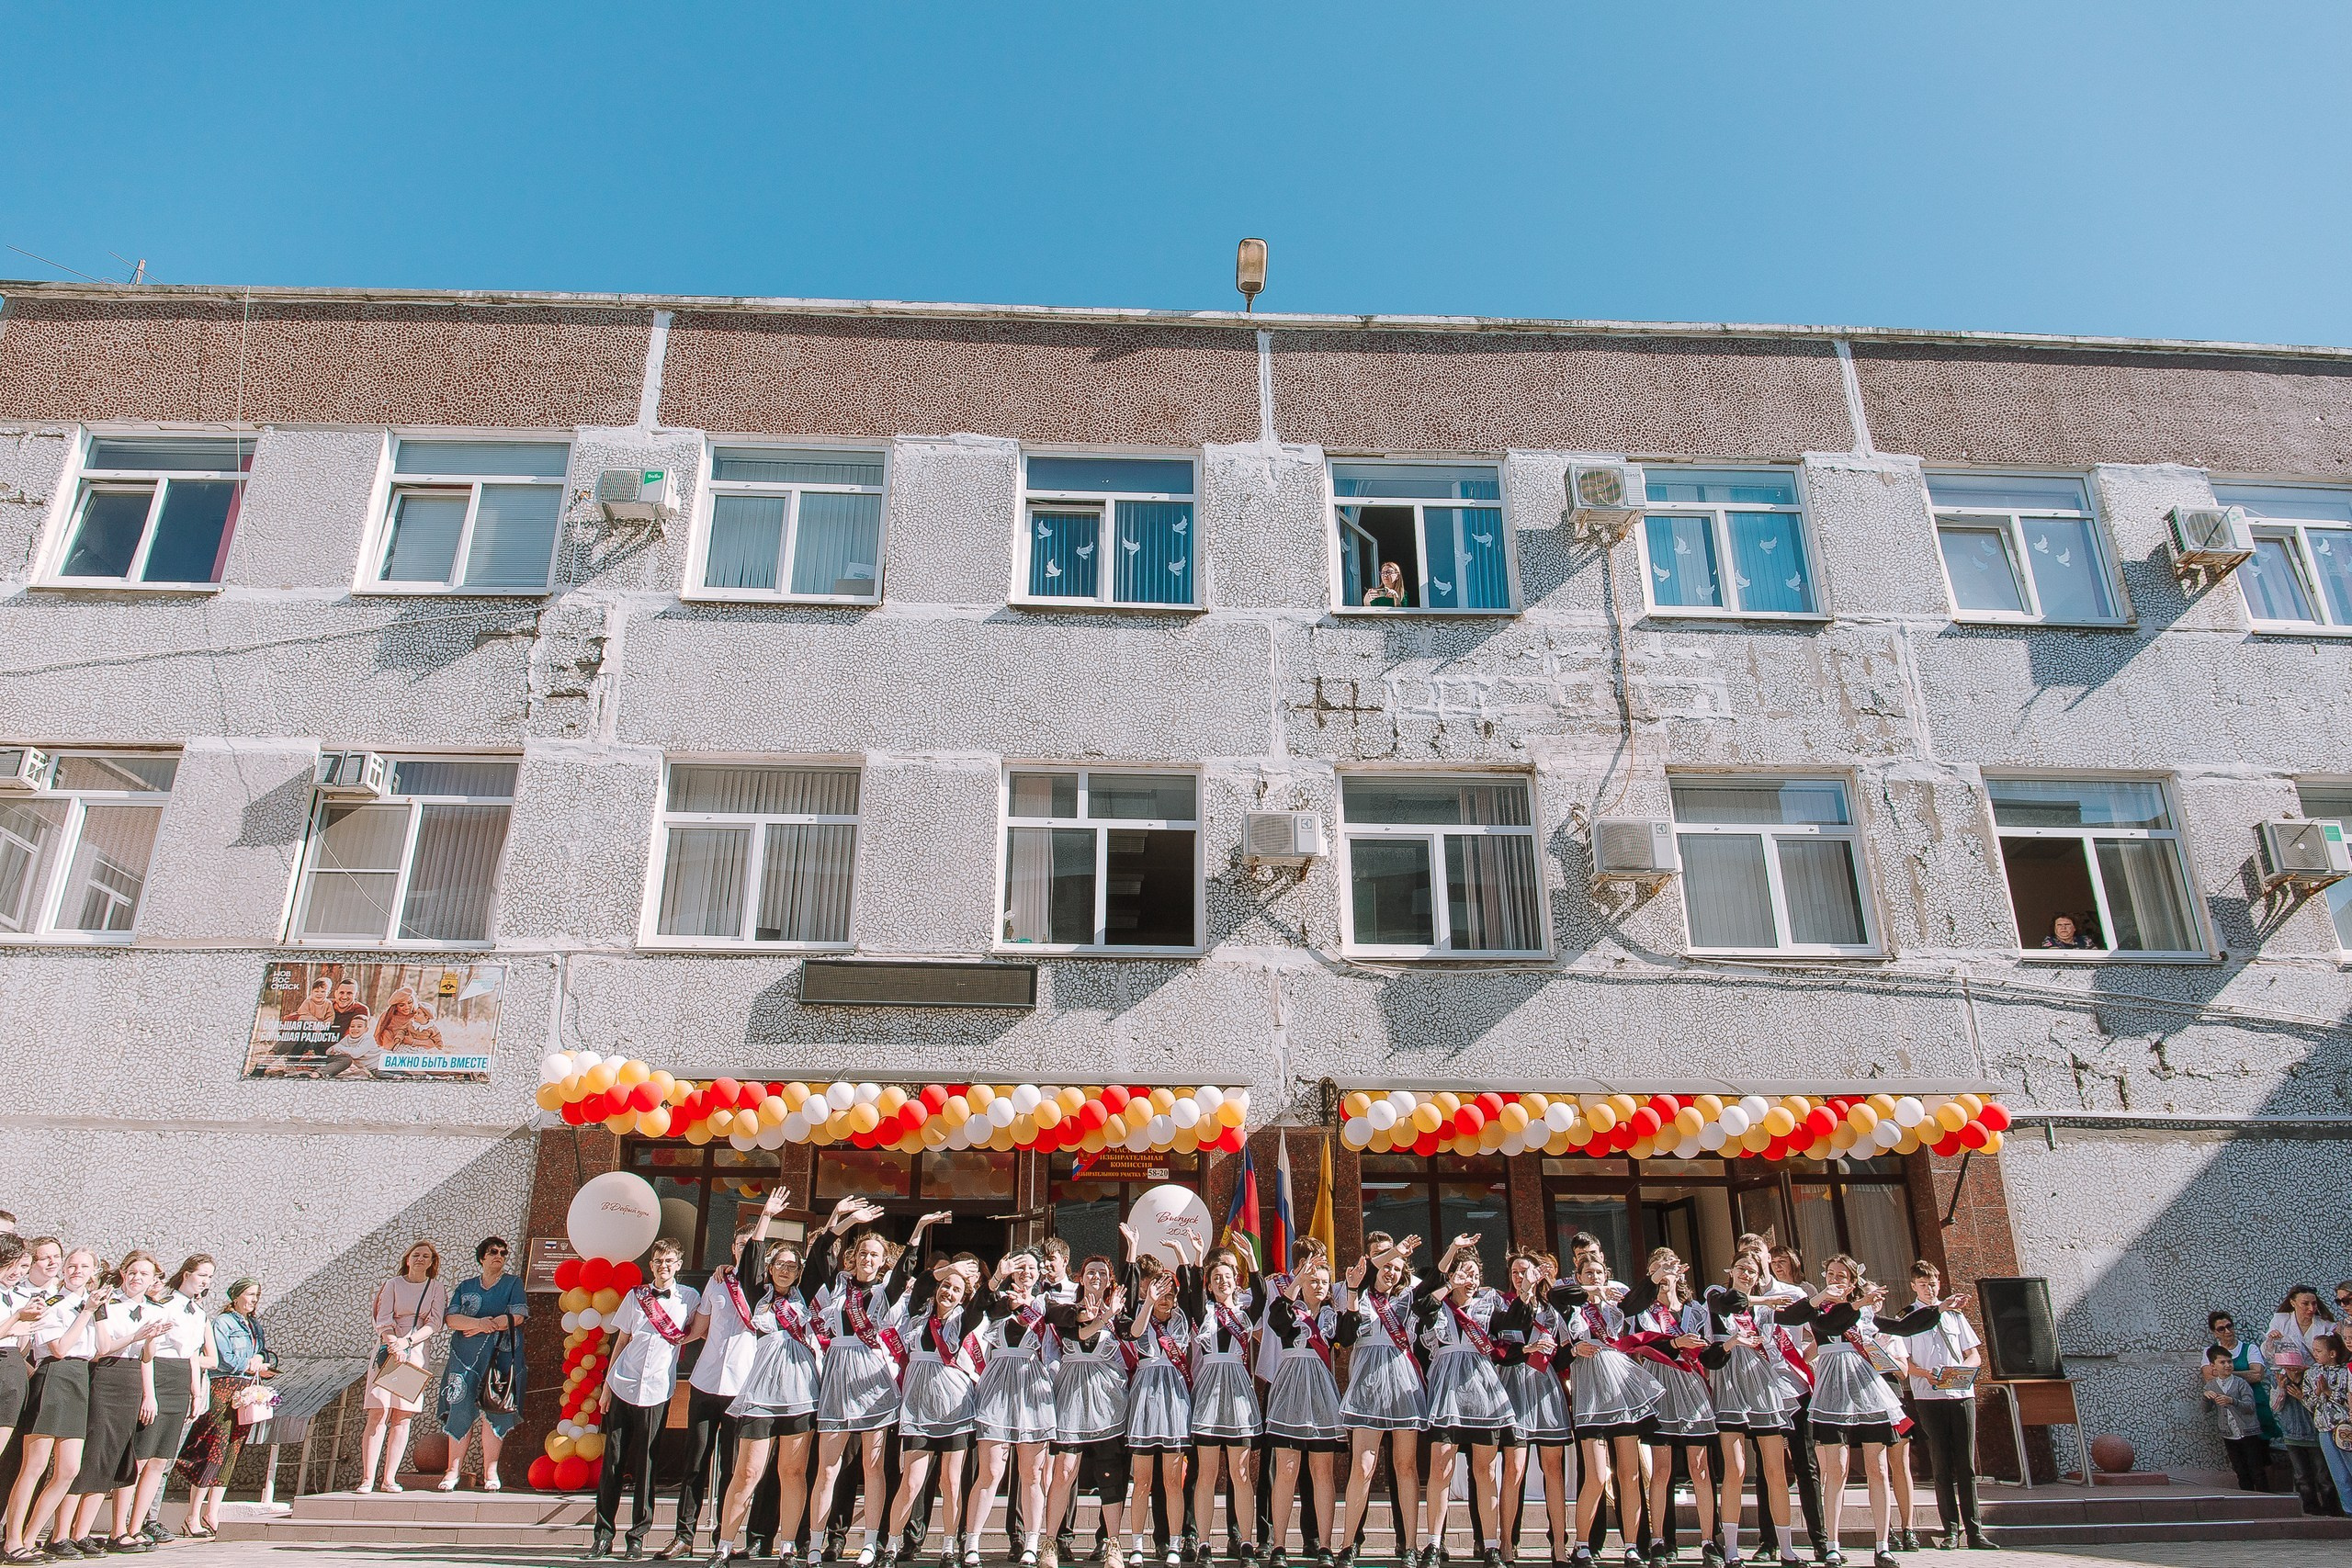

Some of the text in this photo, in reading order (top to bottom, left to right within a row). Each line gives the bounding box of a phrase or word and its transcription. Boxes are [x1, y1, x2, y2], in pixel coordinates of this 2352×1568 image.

[263, 1021, 302, 1031] БОЛЬШАЯ
[302, 1021, 331, 1031] СЕМЬЯ
[260, 1032, 341, 1043] БОЛЬШАЯ РАДОСТЬ!
[385, 1055, 488, 1068] ВАЖНО БЫТЬ ВМЕСТЕ
[1155, 1211, 1199, 1227] Выпуск
[1166, 1227, 1193, 1236] 202
